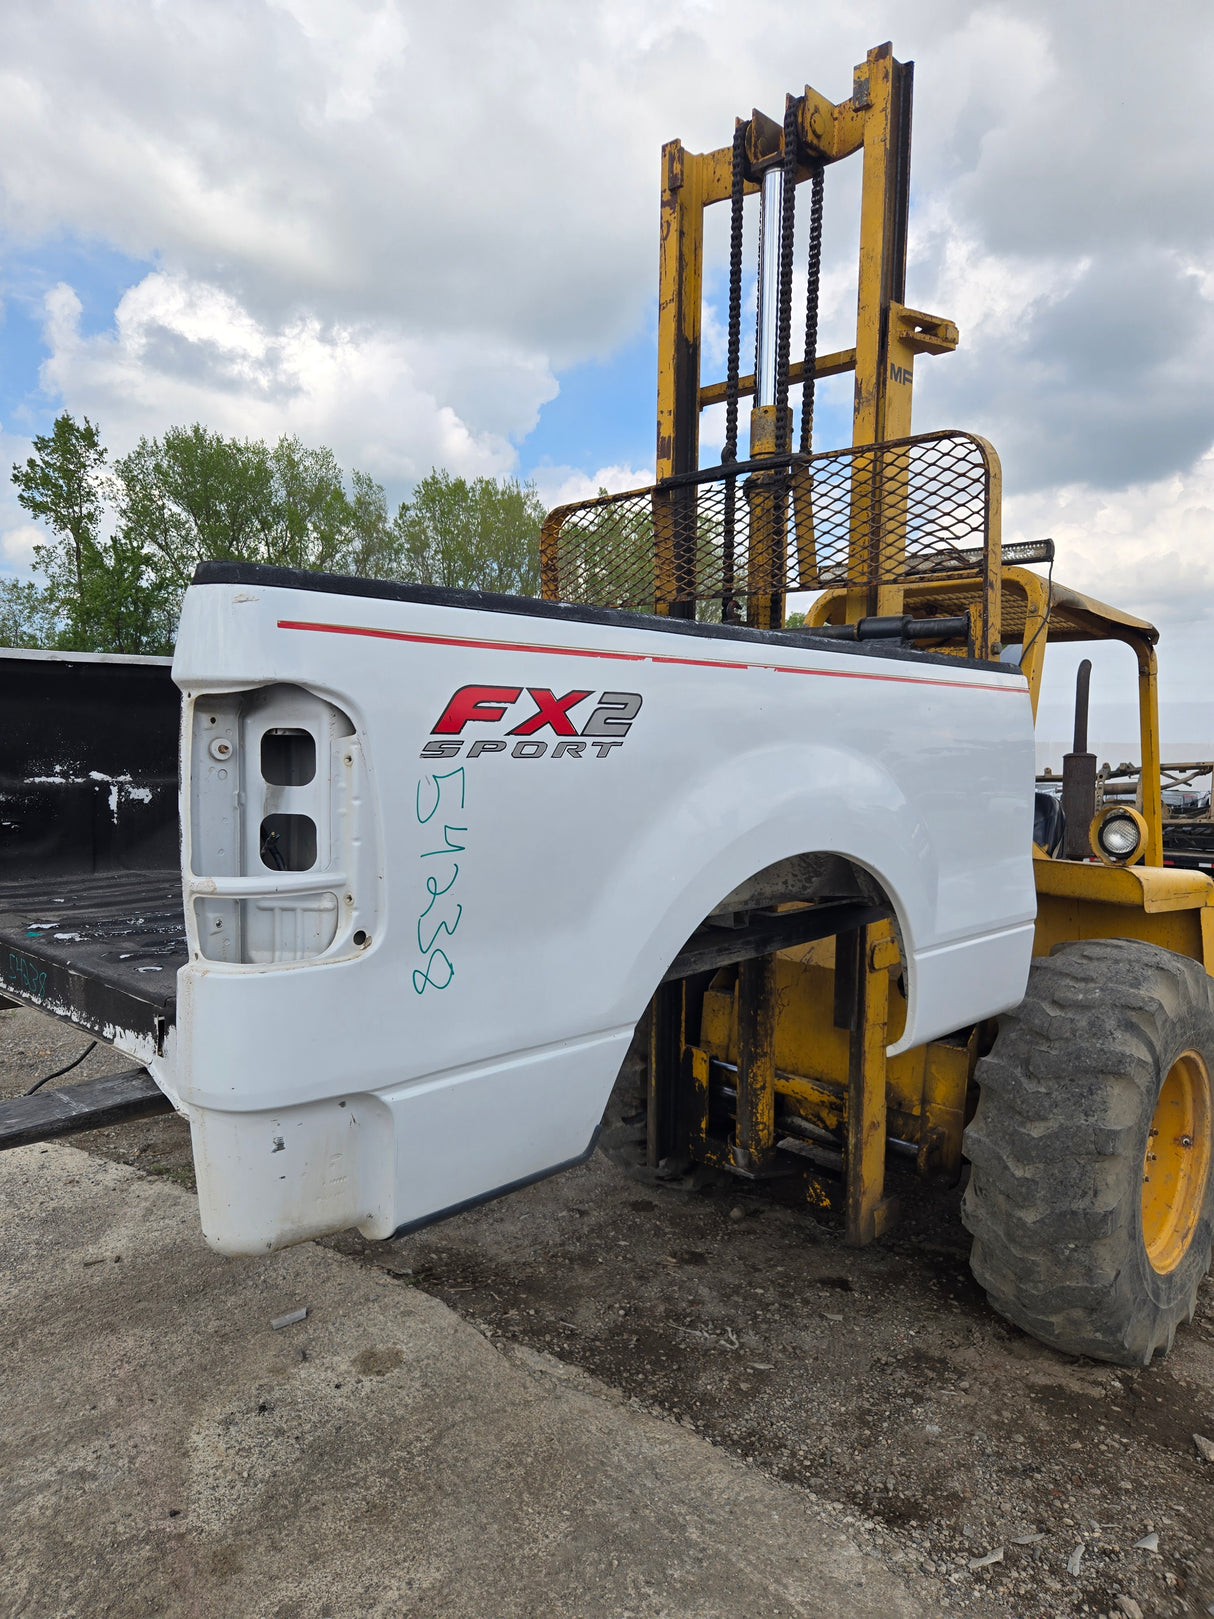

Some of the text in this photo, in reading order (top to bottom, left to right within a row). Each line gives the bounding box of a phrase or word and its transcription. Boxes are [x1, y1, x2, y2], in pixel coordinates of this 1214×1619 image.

[889, 362, 914, 386] MF
[429, 684, 643, 737] FX2
[419, 740, 623, 758] SPORT
[413, 766, 467, 994] 54238
